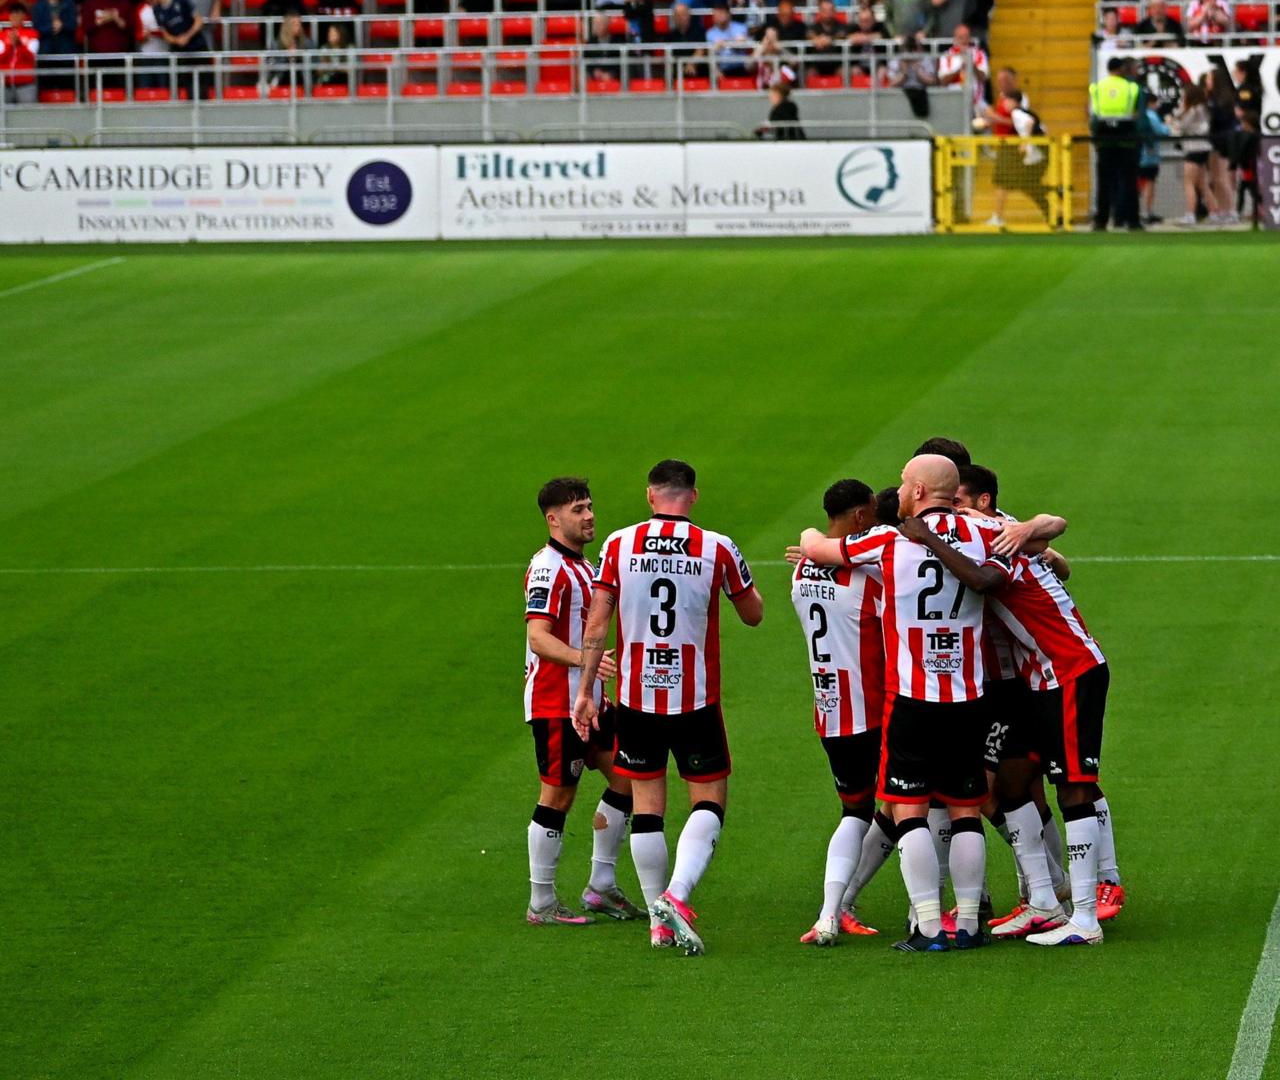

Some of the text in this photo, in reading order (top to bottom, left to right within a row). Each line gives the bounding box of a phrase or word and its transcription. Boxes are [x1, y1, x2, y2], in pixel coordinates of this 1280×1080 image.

[225, 159, 333, 190] DUFFY
[455, 151, 607, 181] Filtered
[456, 183, 806, 214] Aesthetics & Medispa
[77, 212, 334, 233] INSOLVENCY PRACTITIONERS
[645, 537, 680, 554] GMK
[630, 558, 703, 576] P. MC CLEAN
[799, 583, 836, 601] COTTER
[917, 559, 968, 621] 27
[649, 577, 677, 638] 3
[809, 602, 832, 663] 2
